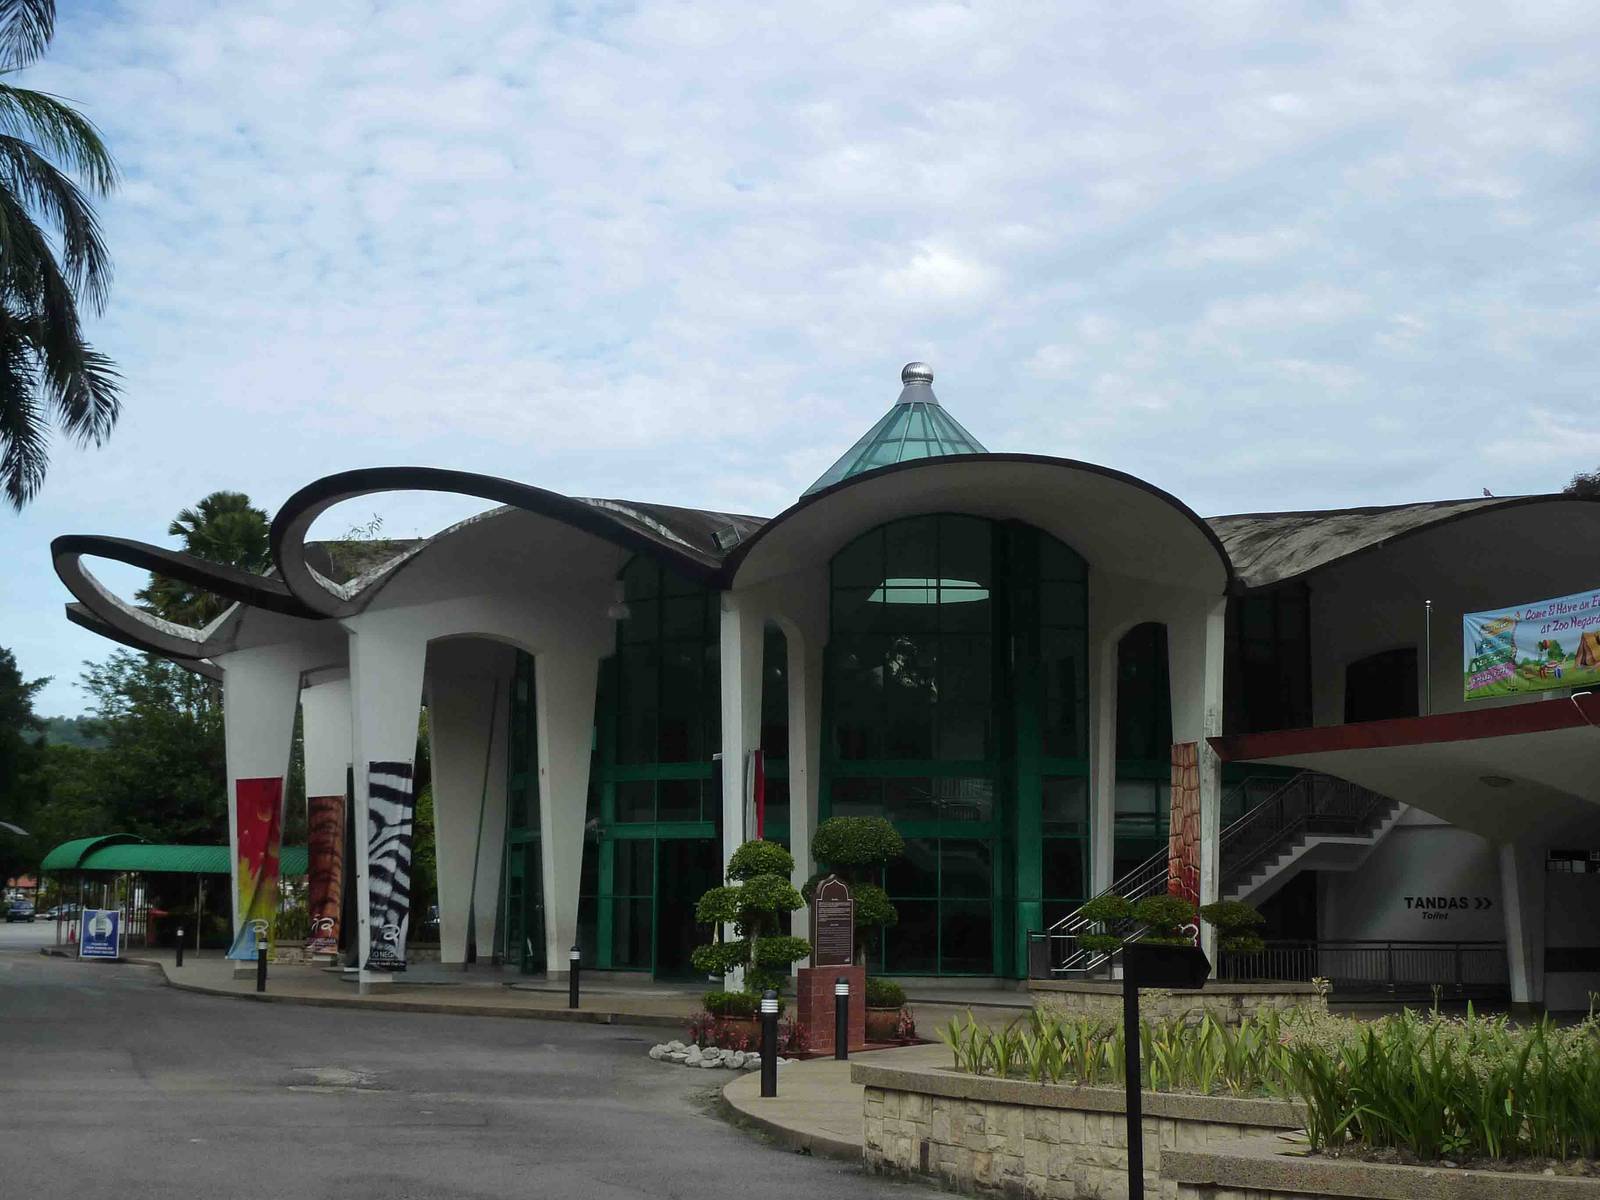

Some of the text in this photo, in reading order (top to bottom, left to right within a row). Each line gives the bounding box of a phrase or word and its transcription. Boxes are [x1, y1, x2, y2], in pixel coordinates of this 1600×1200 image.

[1526, 609, 1547, 620] Come
[1557, 602, 1577, 614] Have
[1579, 600, 1590, 610] an
[1541, 623, 1551, 634] at
[1553, 620, 1570, 631] Zoo
[1404, 897, 1469, 909] TANDAS
[1422, 912, 1448, 920] Toilet
